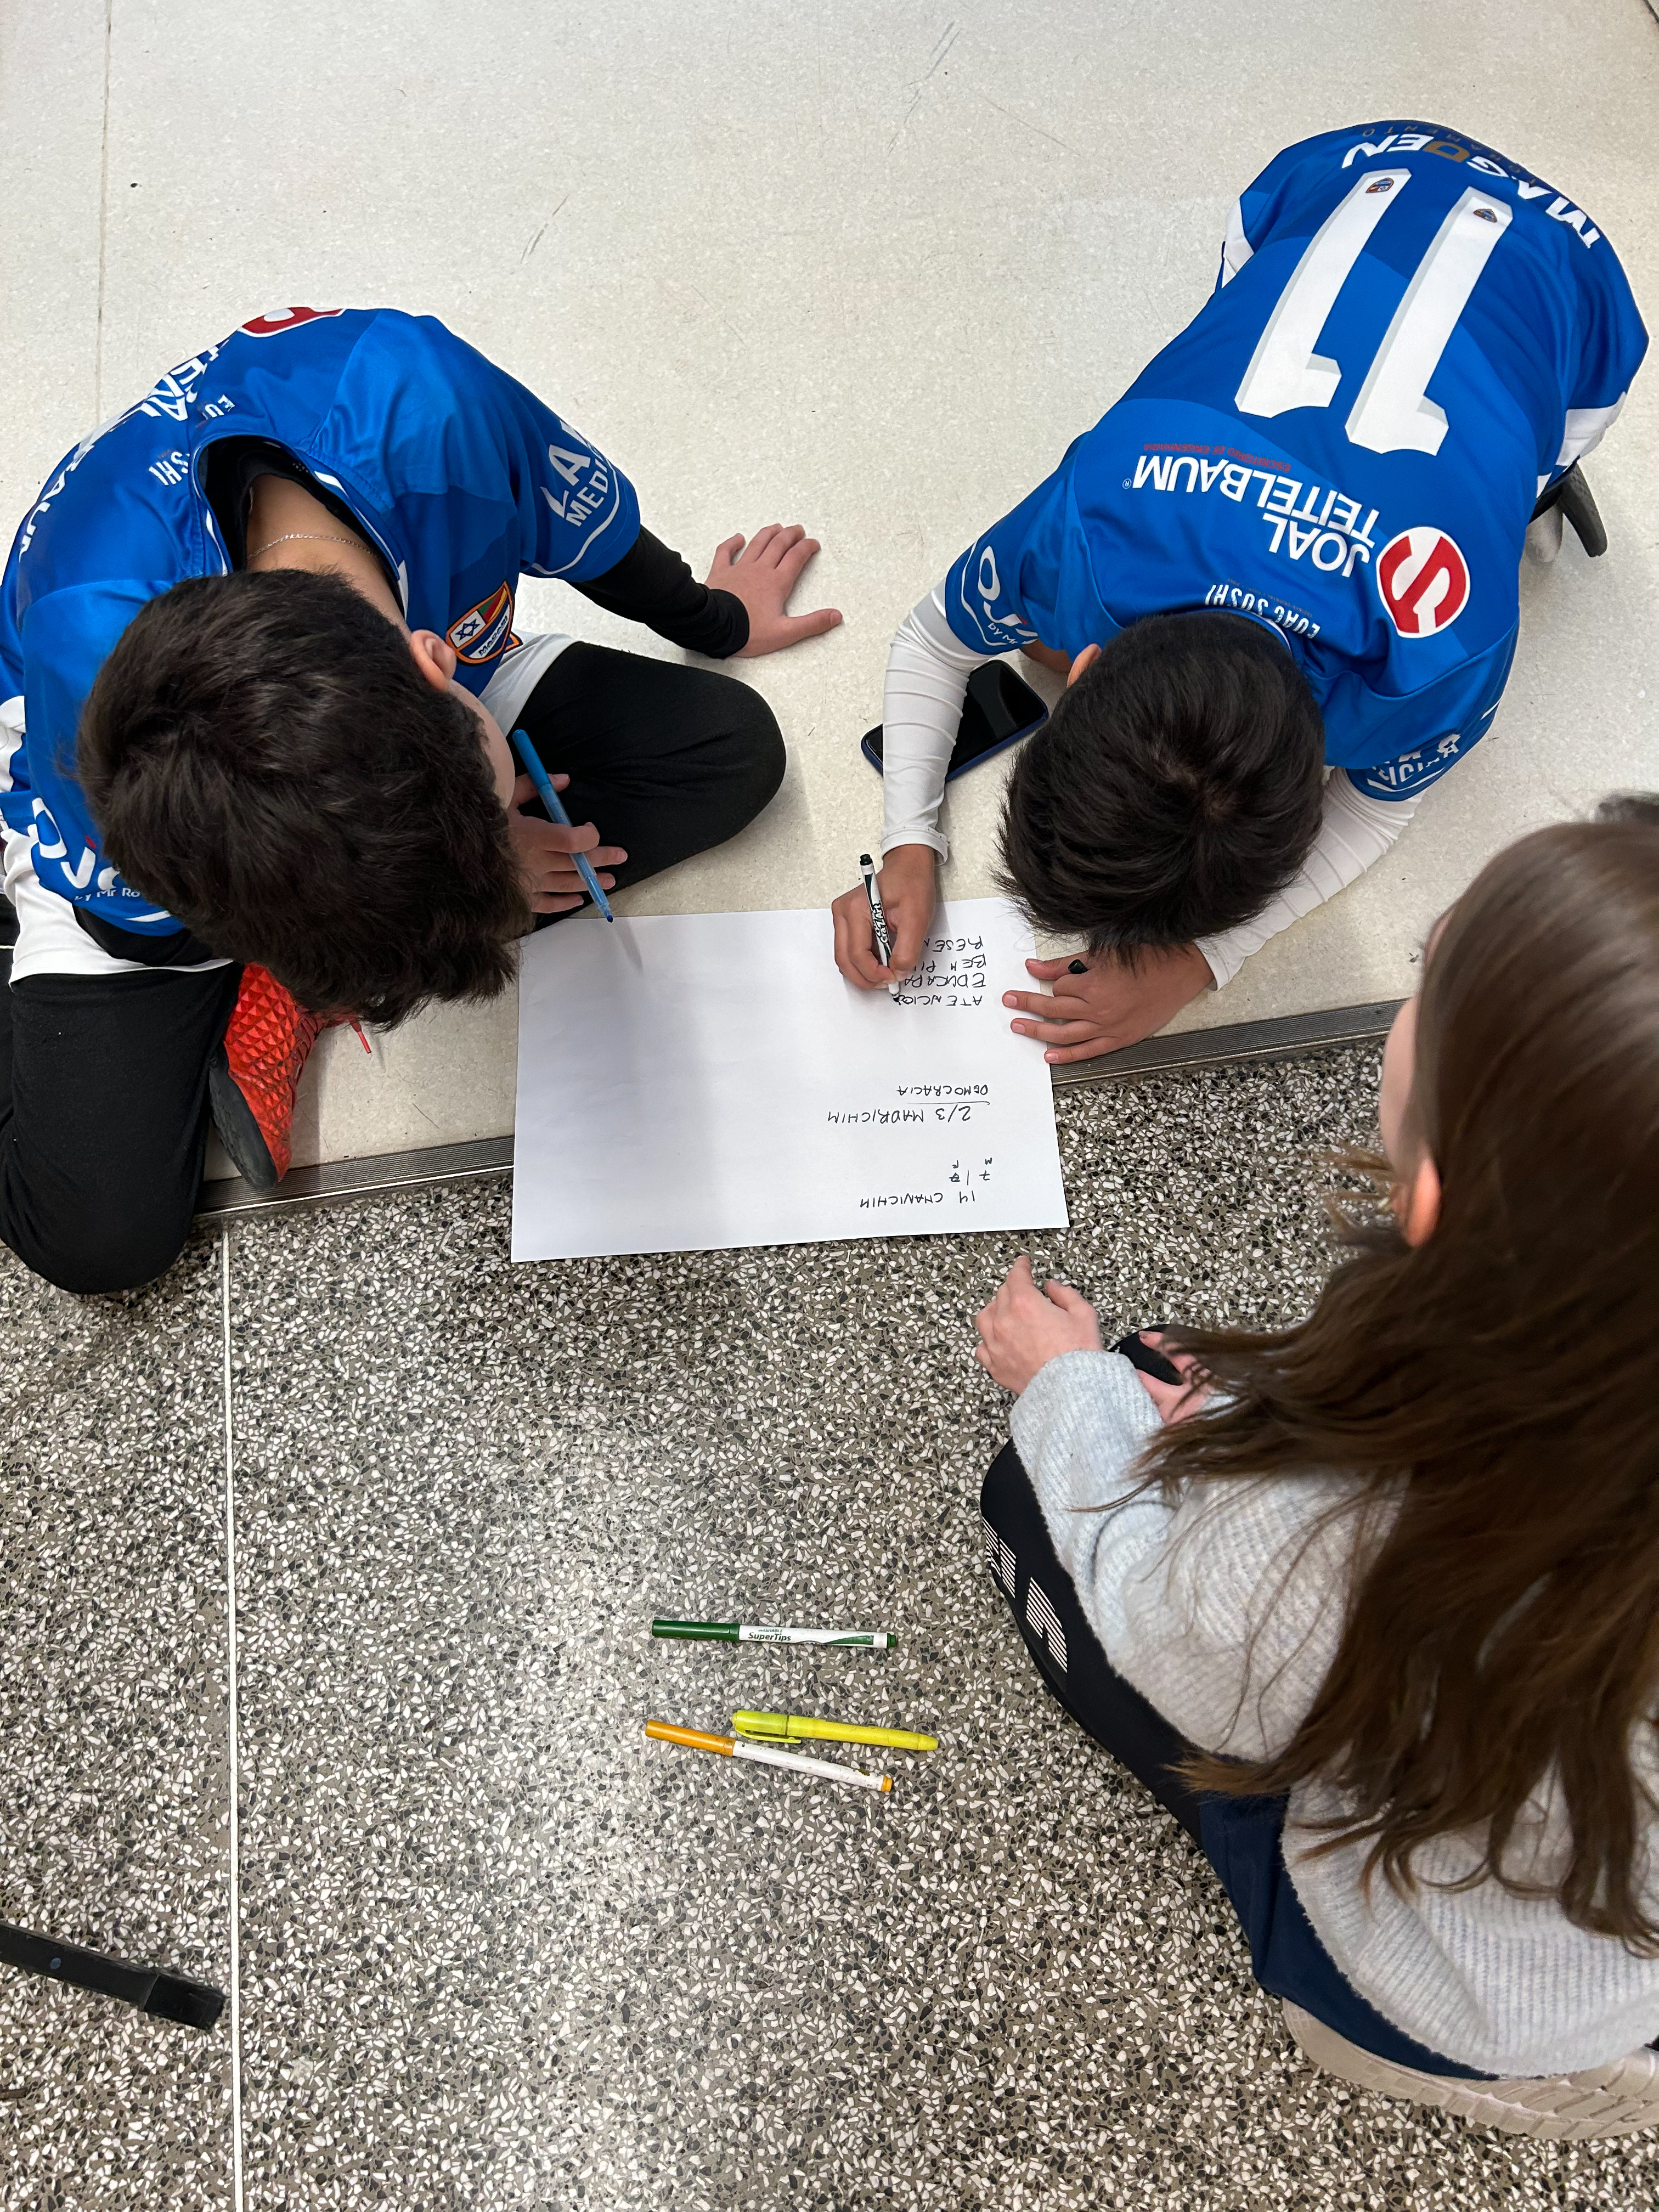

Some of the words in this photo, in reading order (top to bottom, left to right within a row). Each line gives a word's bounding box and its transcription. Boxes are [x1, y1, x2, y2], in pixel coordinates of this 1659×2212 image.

[1235, 168, 1513, 456] 11
[1263, 511, 1372, 578] JOAL
[895, 1084, 989, 1097] DEMOCRACIA
[935, 1104, 971, 1122] 2/3
[985, 1157, 992, 1165] M
[979, 1170, 991, 1182] 7
[959, 1190, 975, 1204] 14
[748, 1631, 792, 1643] SuperTips
